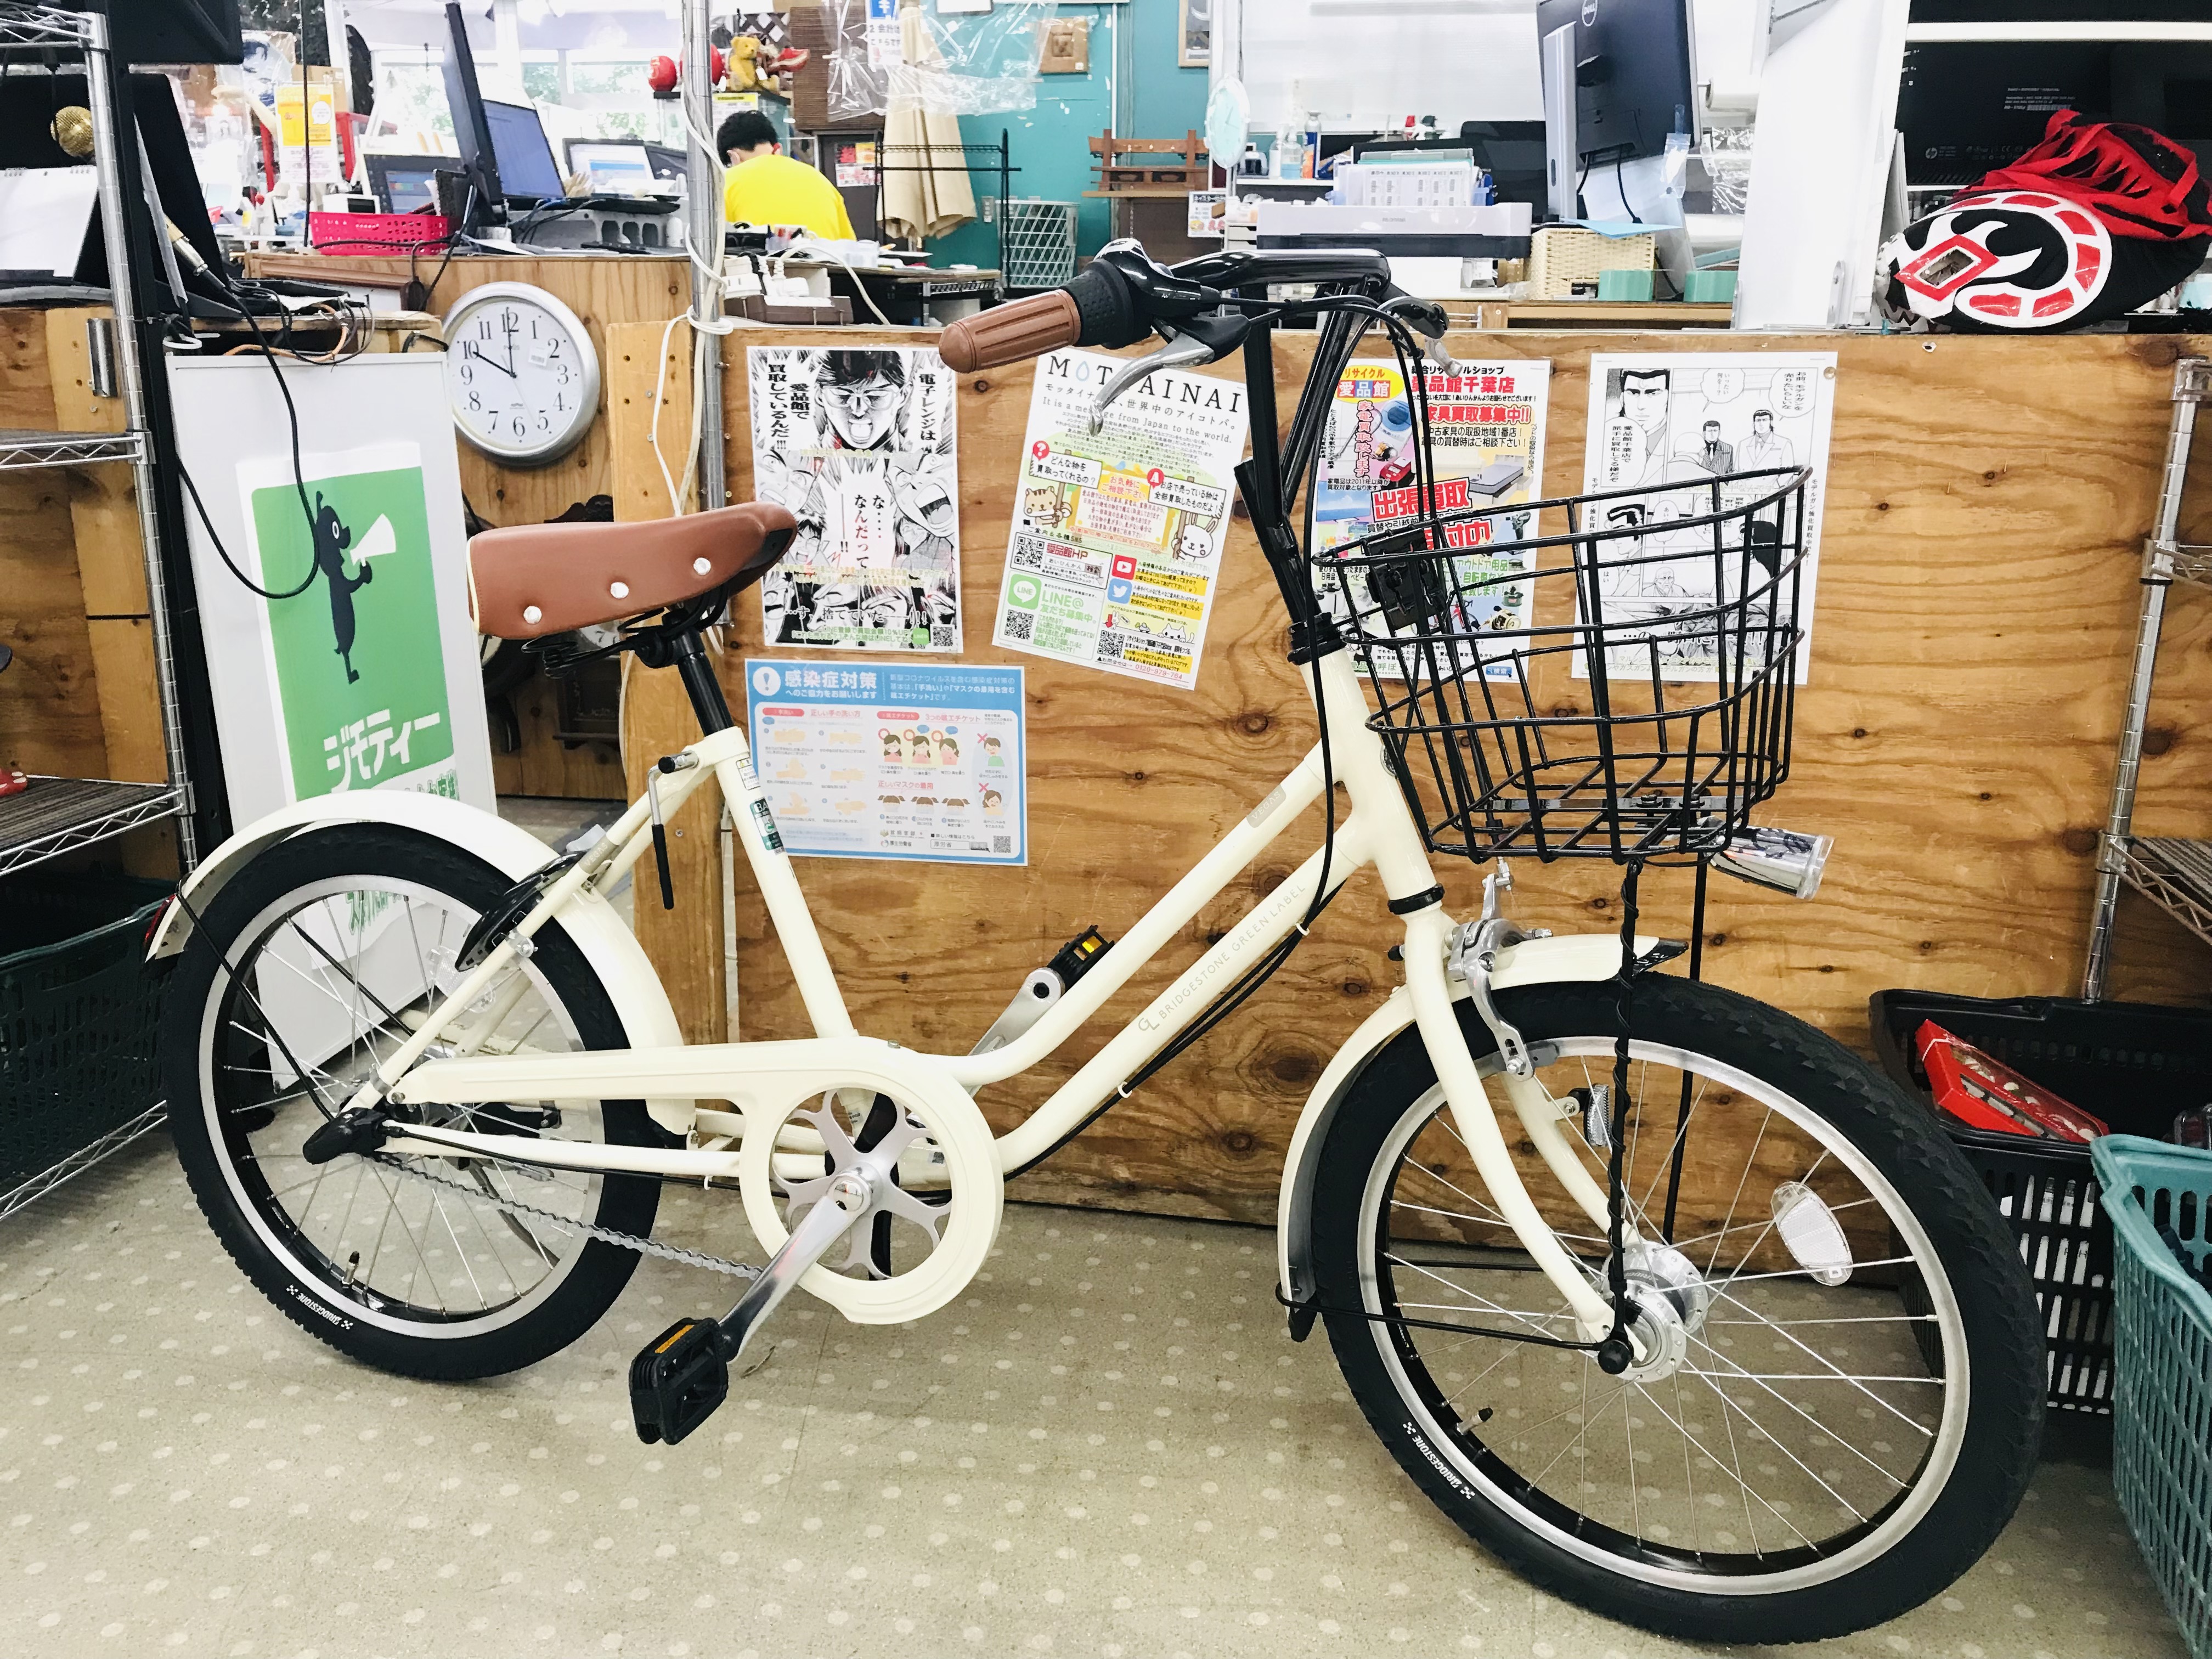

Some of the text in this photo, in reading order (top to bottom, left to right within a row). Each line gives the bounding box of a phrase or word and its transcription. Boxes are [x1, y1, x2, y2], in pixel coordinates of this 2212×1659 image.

[479, 321, 492, 340] 11
[501, 312, 519, 332] 12
[531, 320, 537, 339] 1
[463, 340, 479, 359] 10
[548, 338, 560, 358] 2
[461, 365, 472, 385] 9
[557, 364, 568, 385] 3
[1345, 368, 1385, 379] リサイクル
[1339, 381, 1389, 397] 愛品館
[1782, 373, 1794, 409] 売りたいらしいな
[1794, 372, 1806, 410] お前、モデルガンを
[469, 391, 481, 411] 8
[553, 391, 565, 411] 4
[789, 383, 810, 419] 愛品館で
[919, 374, 936, 441] 電子レンジは
[488, 410, 498, 430] 7
[513, 416, 525, 436] 6
[538, 410, 548, 430] 5
[1042, 396, 1051, 405] It
[1053, 398, 1062, 408] is
[1118, 413, 1139, 424] from
[1143, 418, 1168, 431] Japan
[1172, 425, 1181, 433] to
[1185, 427, 1200, 436] the
[1203, 431, 1232, 443] world.
[1610, 426, 1622, 482] 派手に買取してる様だぞ
[1622, 426, 1633, 463] 愛品館千葉店で
[1051, 455, 1086, 471] どんな物を
[1037, 464, 1096, 486] 買取ってくれるの？
[1110, 476, 1141, 489] お気軽に
[1101, 483, 1146, 499] ご相談下さい
[1160, 480, 1219, 501] お店で売っている物は
[1374, 481, 1469, 520] 出張買取
[1154, 490, 1218, 513] 全部買取したものだよ！
[855, 494, 868, 569] なんだって
[1046, 542, 1088, 561] 愛品館HP
[1048, 557, 1082, 569] あいひんかん
[1603, 571, 1610, 583] はい
[1017, 586, 1033, 595] LINE
[1041, 590, 1084, 610] LINE@
[1040, 603, 1097, 624] 友だち募集中。
[785, 670, 877, 689] 感染症対策
[1135, 663, 1182, 680] 0120-979-764
[785, 689, 877, 699] へのご協力をお願いします
[810, 709, 861, 717] 正しい手の洗い方
[925, 714, 981, 722] 3つの咳エチケット
[323, 709, 441, 793] ジモティー
[878, 781, 933, 789] 正しいマスクの着用
[1159, 952, 1231, 1019] BRIDGESTONE
[1231, 916, 1269, 951] GREEN
[1269, 884, 1306, 917] LABEL
[296, 1293, 342, 1325] BRIDGESTONE
[1412, 1435, 1463, 1488] BRIDGESTONE
